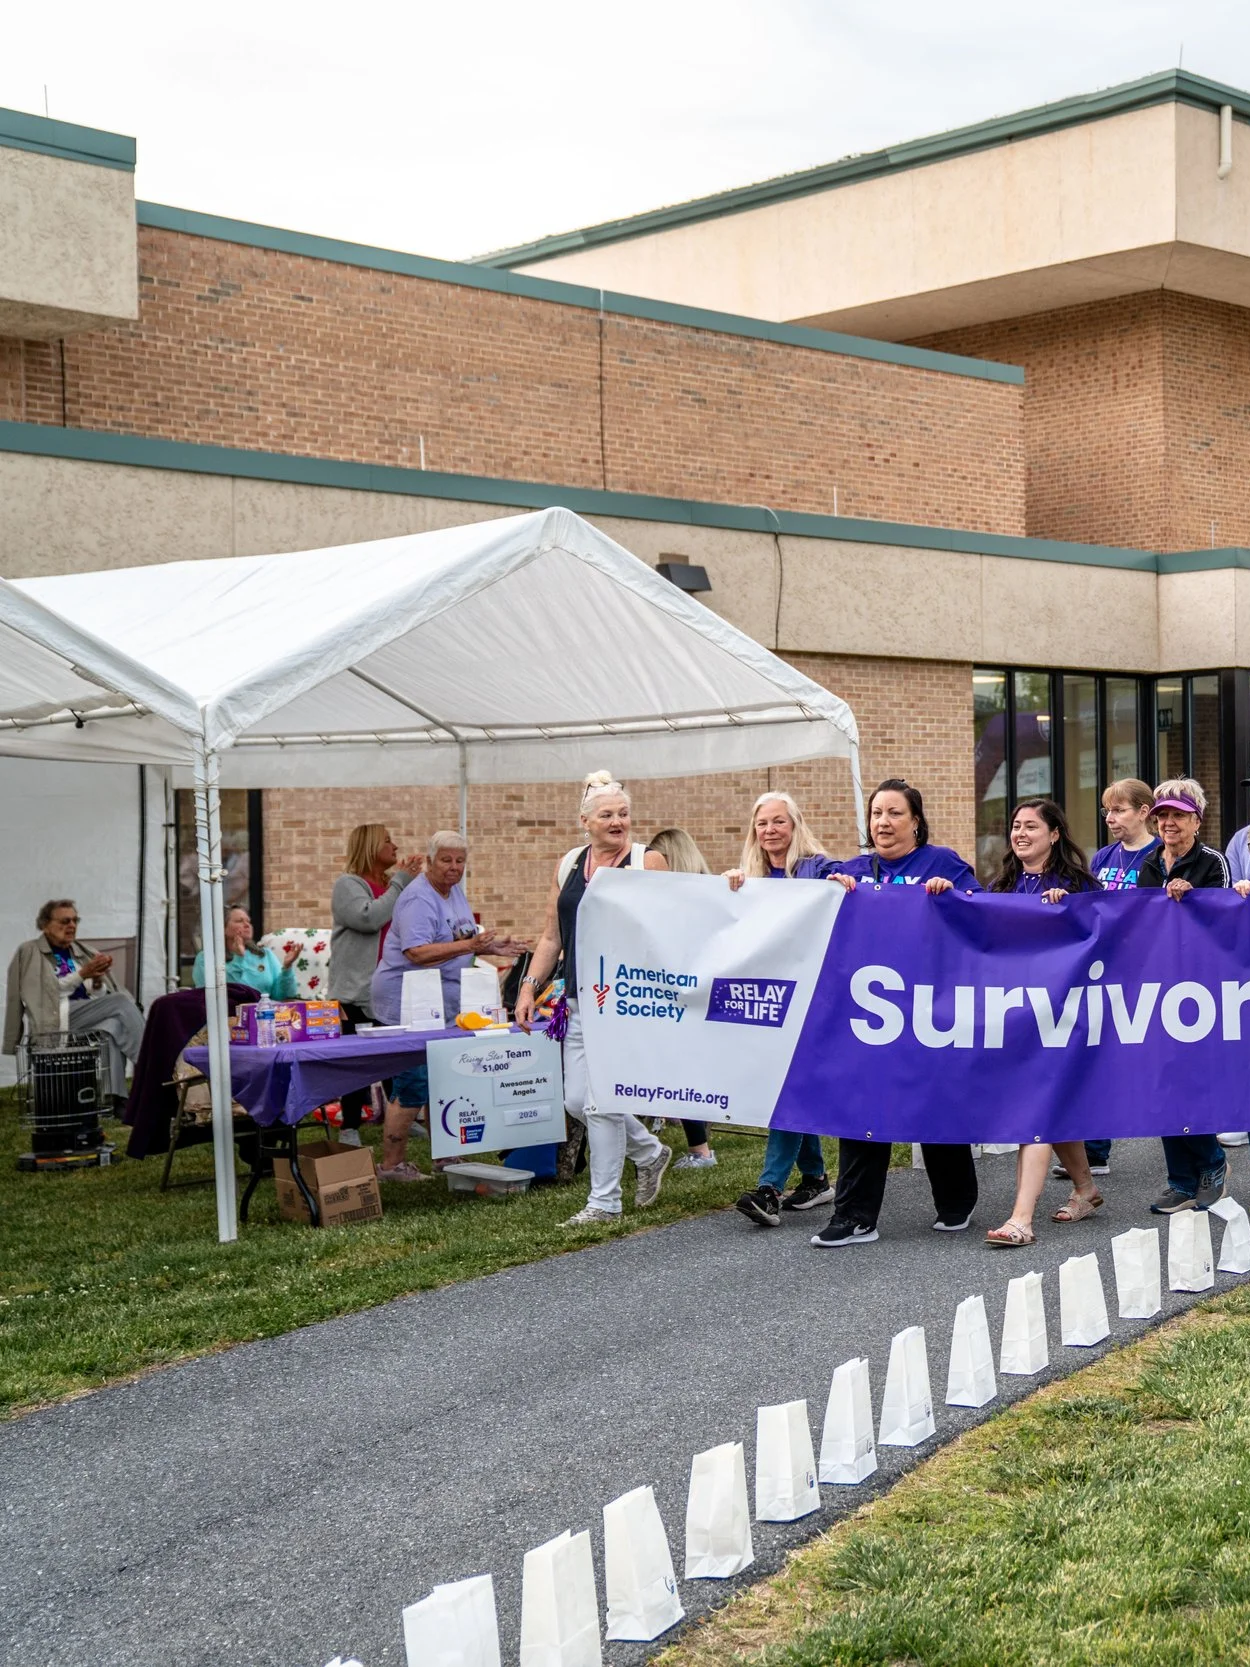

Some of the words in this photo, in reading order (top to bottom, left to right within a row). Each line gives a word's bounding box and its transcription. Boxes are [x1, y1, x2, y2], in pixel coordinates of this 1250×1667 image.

[615, 963, 698, 988] American
[615, 982, 679, 1001] Cancer
[729, 984, 787, 1003] RELAY
[616, 1000, 686, 1022] Society
[725, 1000, 744, 1010] FOR
[459, 1053, 483, 1064] Rising
[486, 1050, 504, 1061] Star
[505, 1049, 532, 1059] Team
[482, 1062, 509, 1073] $1,000
[500, 1079, 533, 1088] Awesome
[512, 1088, 537, 1097] Angels
[615, 1084, 729, 1109] RelayForLife.org
[518, 1110, 538, 1119] 2026
